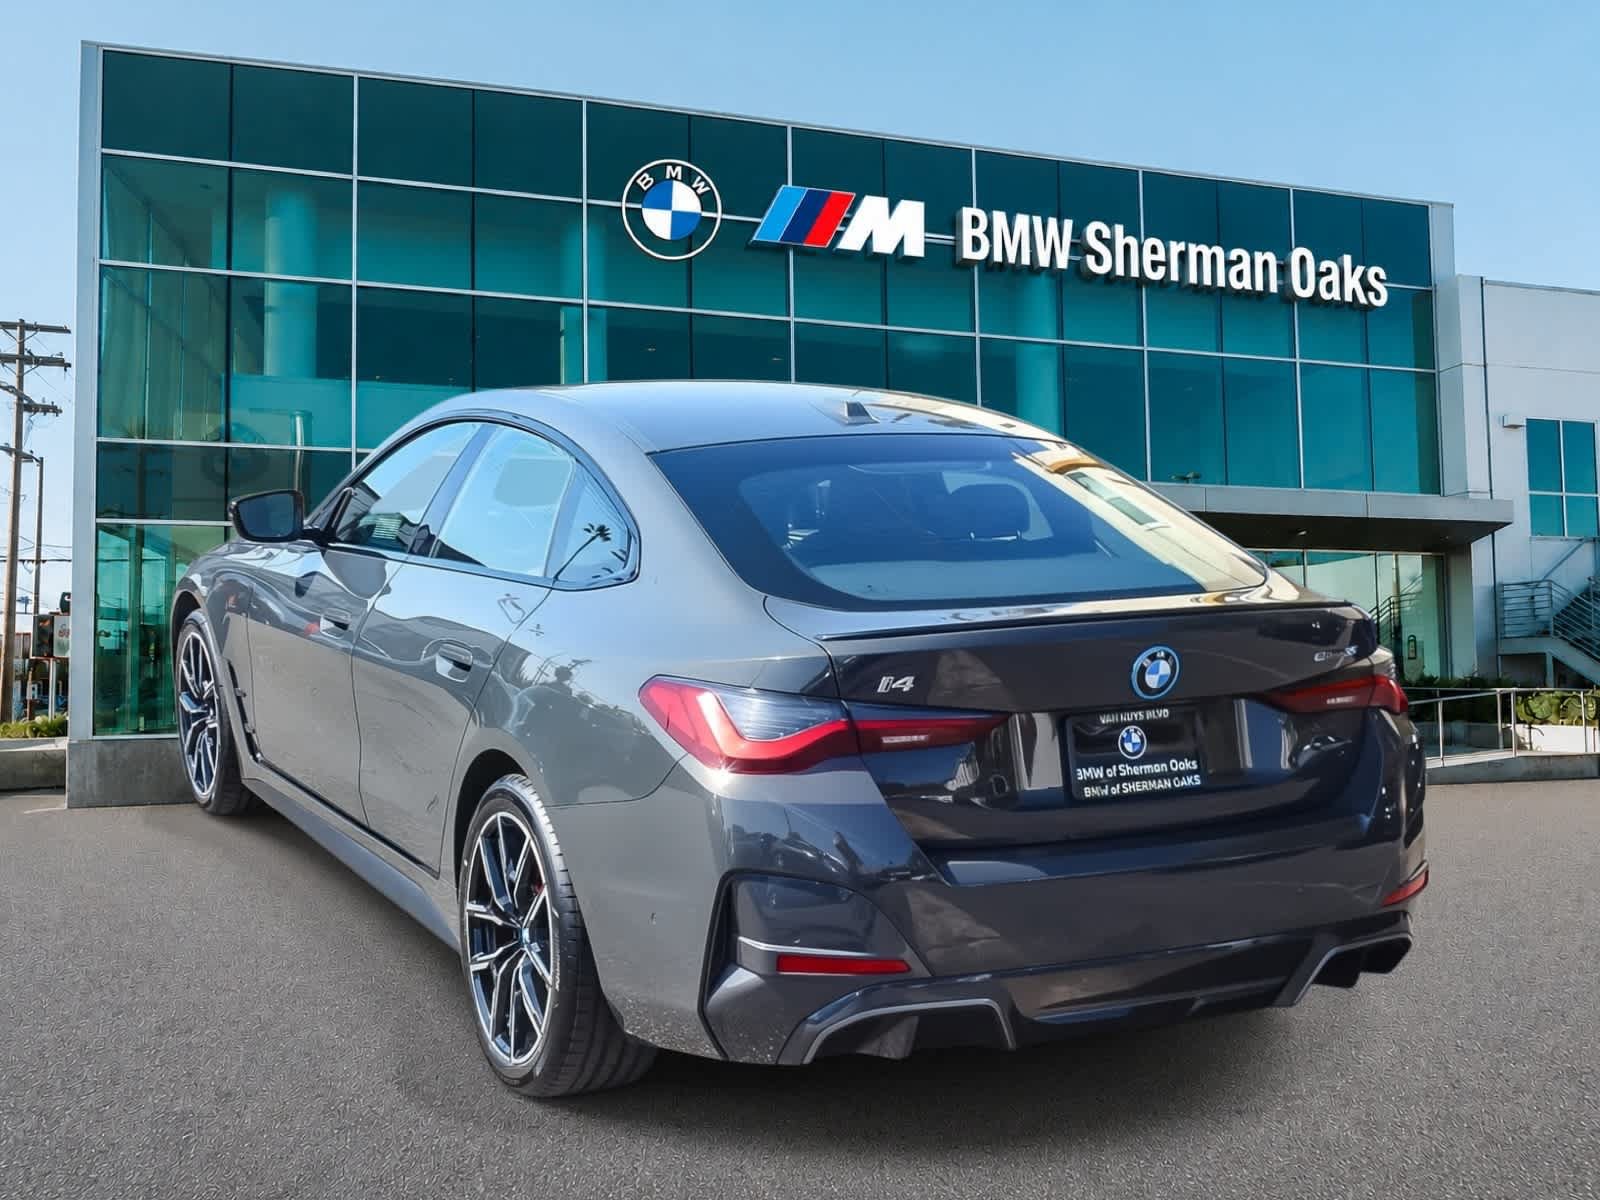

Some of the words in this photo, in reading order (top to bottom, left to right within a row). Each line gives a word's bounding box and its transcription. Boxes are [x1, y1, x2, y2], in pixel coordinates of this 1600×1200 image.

[636, 165, 711, 195] BMW
[961, 207, 1074, 270] BMW
[1085, 221, 1279, 294] Sherman
[1290, 247, 1389, 308] Oaks
[1106, 764, 1117, 778] of
[1118, 763, 1168, 776] Sherman
[1169, 758, 1198, 771] Oaks
[1110, 783, 1120, 795] of
[1121, 778, 1172, 793] SHERMAN
[1172, 774, 1201, 788] OAKS
